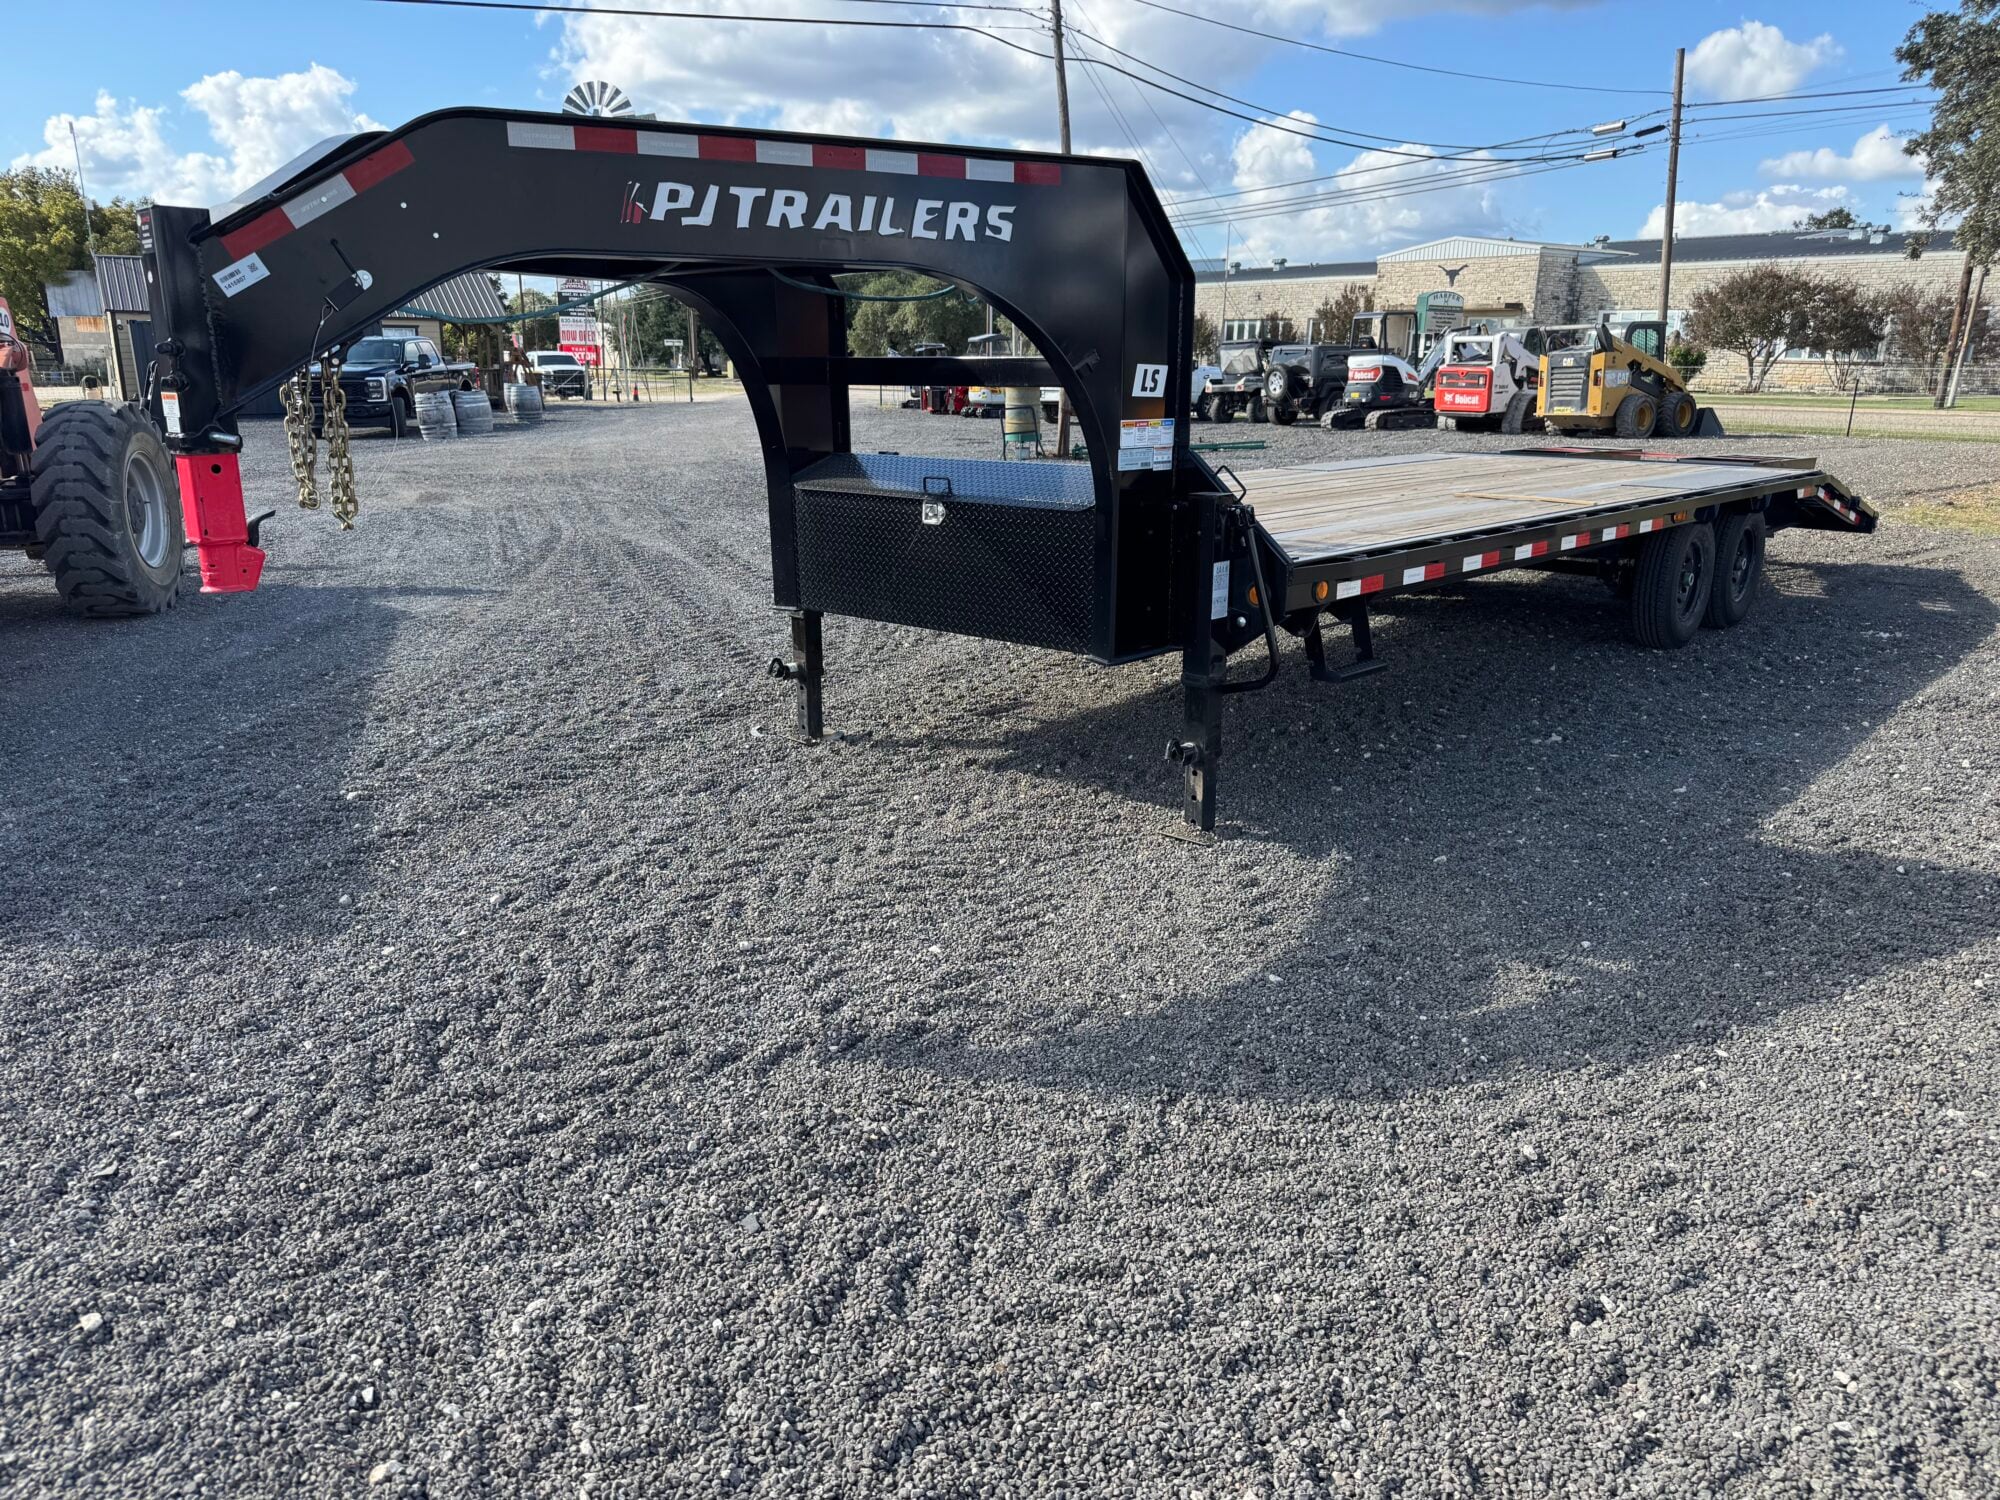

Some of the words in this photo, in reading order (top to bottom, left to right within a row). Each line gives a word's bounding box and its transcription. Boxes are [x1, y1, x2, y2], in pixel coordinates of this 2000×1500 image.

[649, 182, 719, 226] PJ
[729, 186, 1017, 242] TRAILERS
[561, 330, 577, 342] NOW
[1562, 357, 1574, 367] CAT
[1140, 368, 1160, 392] LS
[1353, 370, 1375, 380] Bobcat
[1454, 393, 1479, 405] Bobcat
